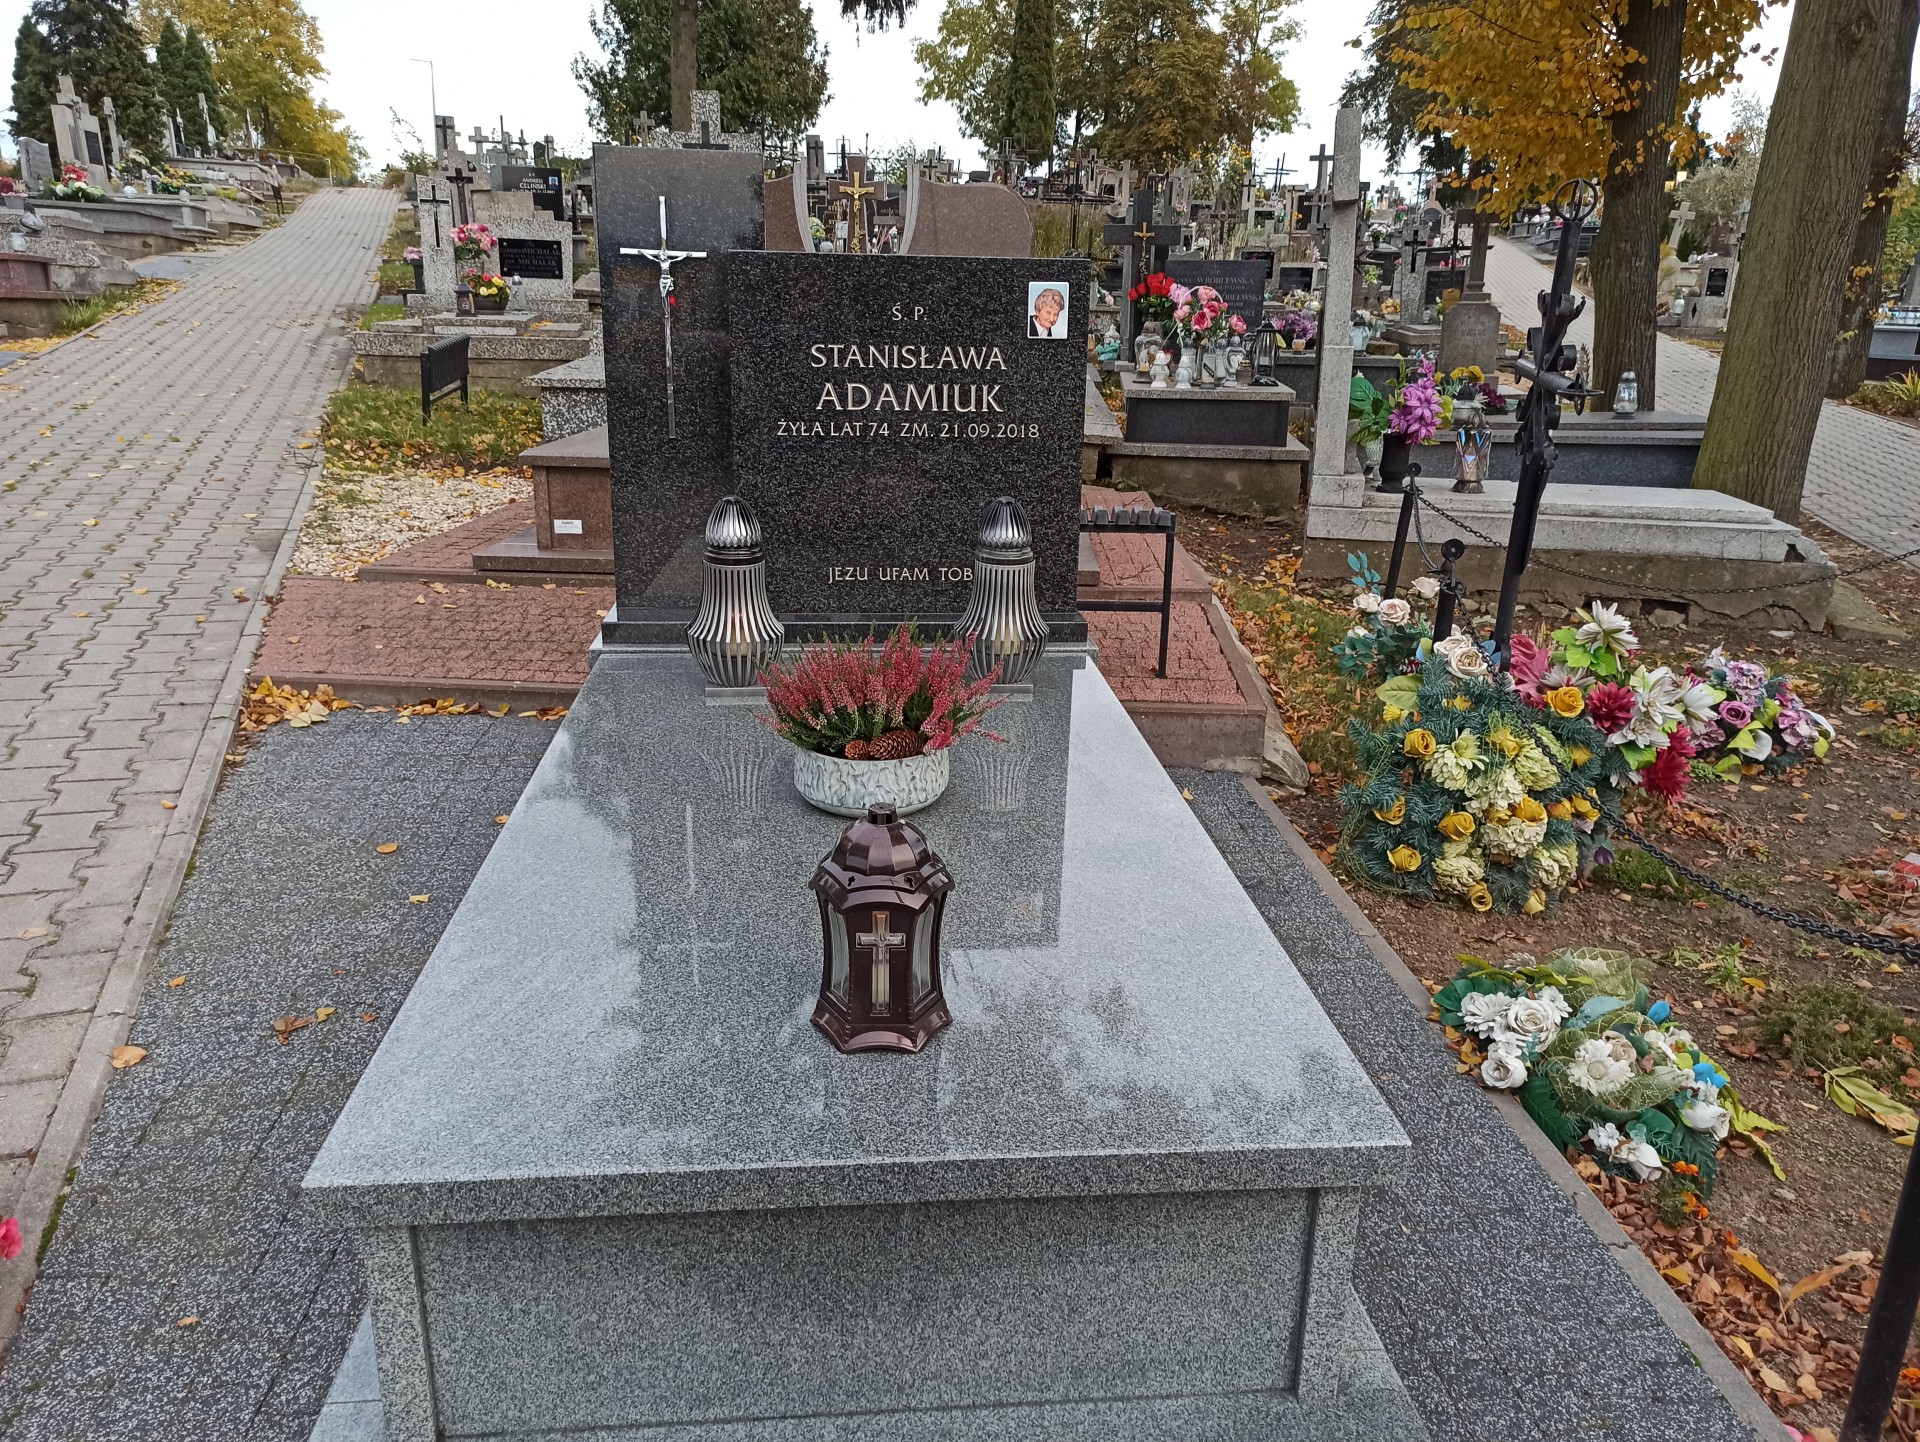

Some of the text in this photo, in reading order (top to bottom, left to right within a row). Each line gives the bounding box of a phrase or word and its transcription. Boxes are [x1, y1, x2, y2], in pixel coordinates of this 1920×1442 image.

[892, 302, 928, 321] Ś. P.
[810, 344, 1008, 370] STANISŁAWA
[815, 382, 1004, 413] ADAMIUK
[777, 418, 1040, 438] ŻYŁA LAT 74 ZM. 21.09.2018
[828, 567, 974, 584] JEZU UFAM TOB
